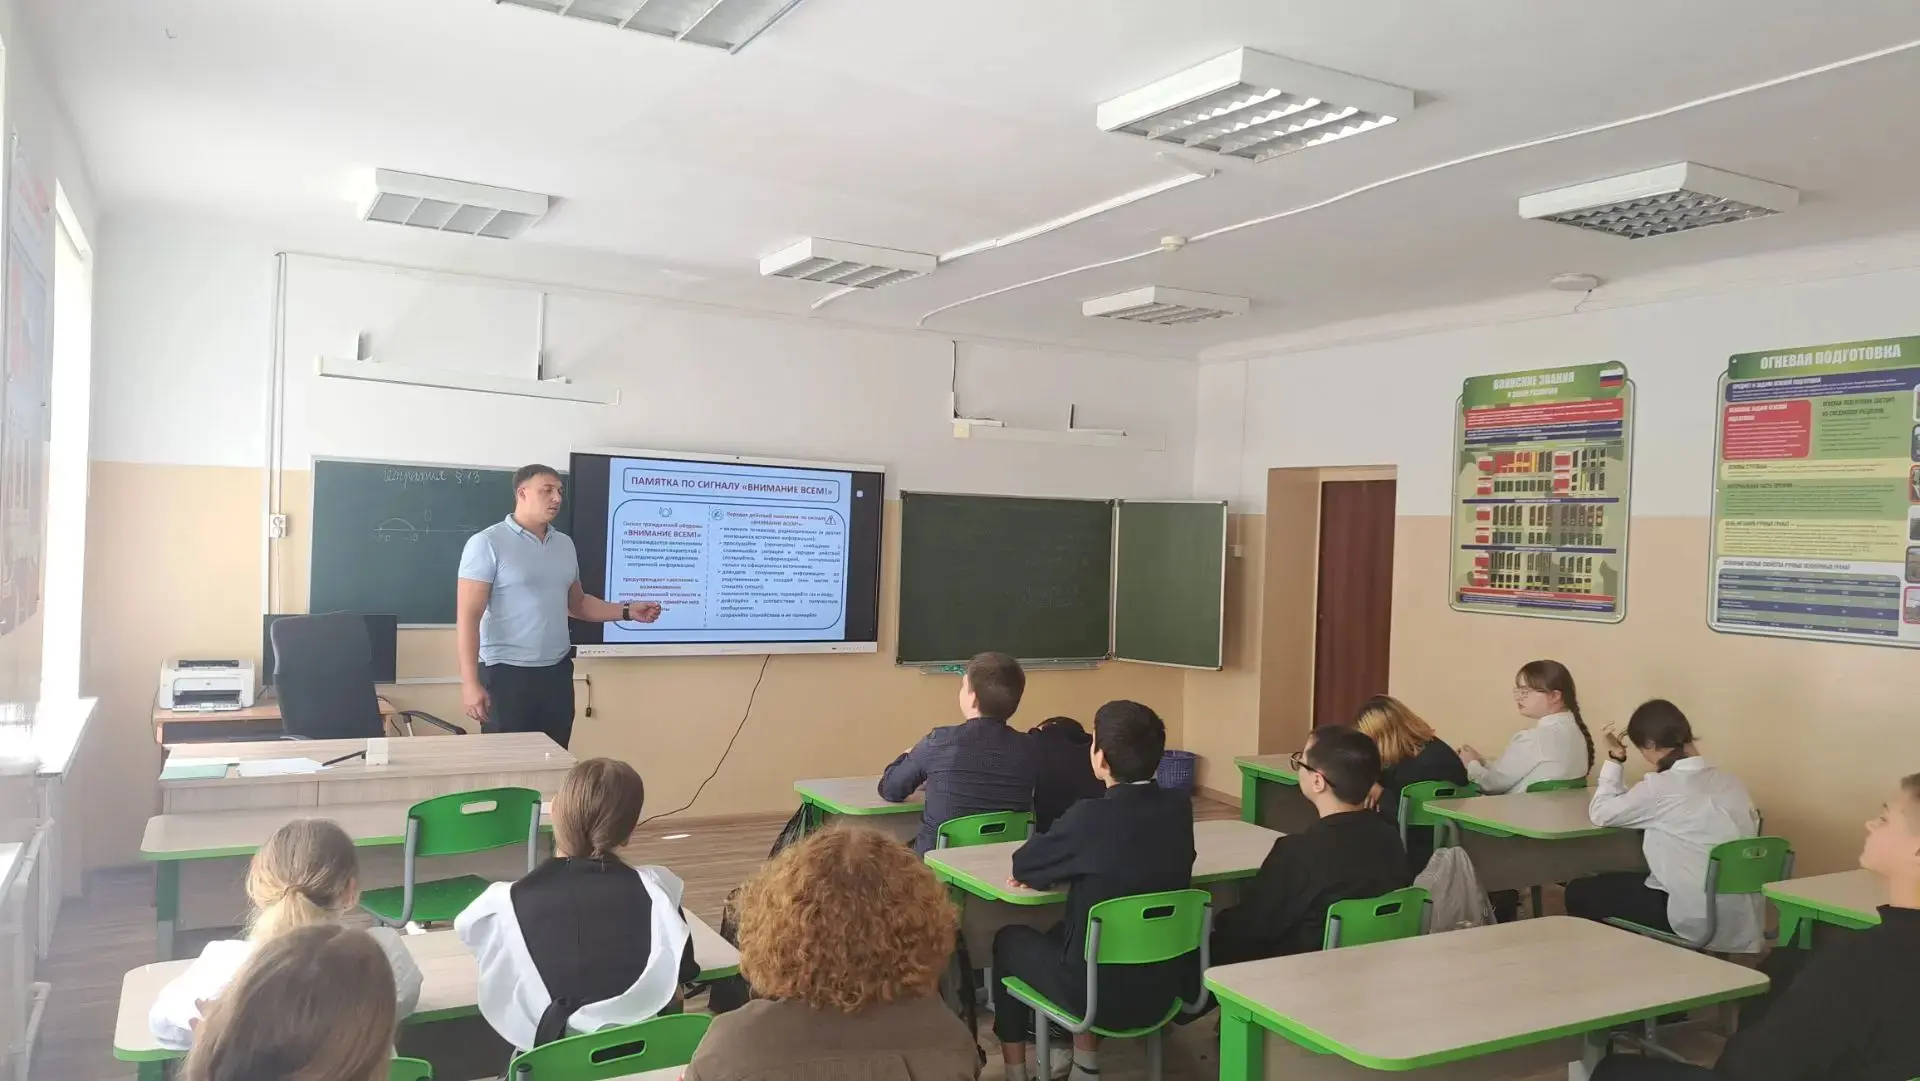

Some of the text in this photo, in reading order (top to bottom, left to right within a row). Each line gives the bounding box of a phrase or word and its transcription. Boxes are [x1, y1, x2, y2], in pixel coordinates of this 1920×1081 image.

[1760, 344, 1901, 370] ОГНЕВАЯ ПОДГОТОВКА
[631, 476, 833, 496] ПАМЯТКА ПО СИГНАЛУ «ВНИМАНИЕ ВСЕМ!»
